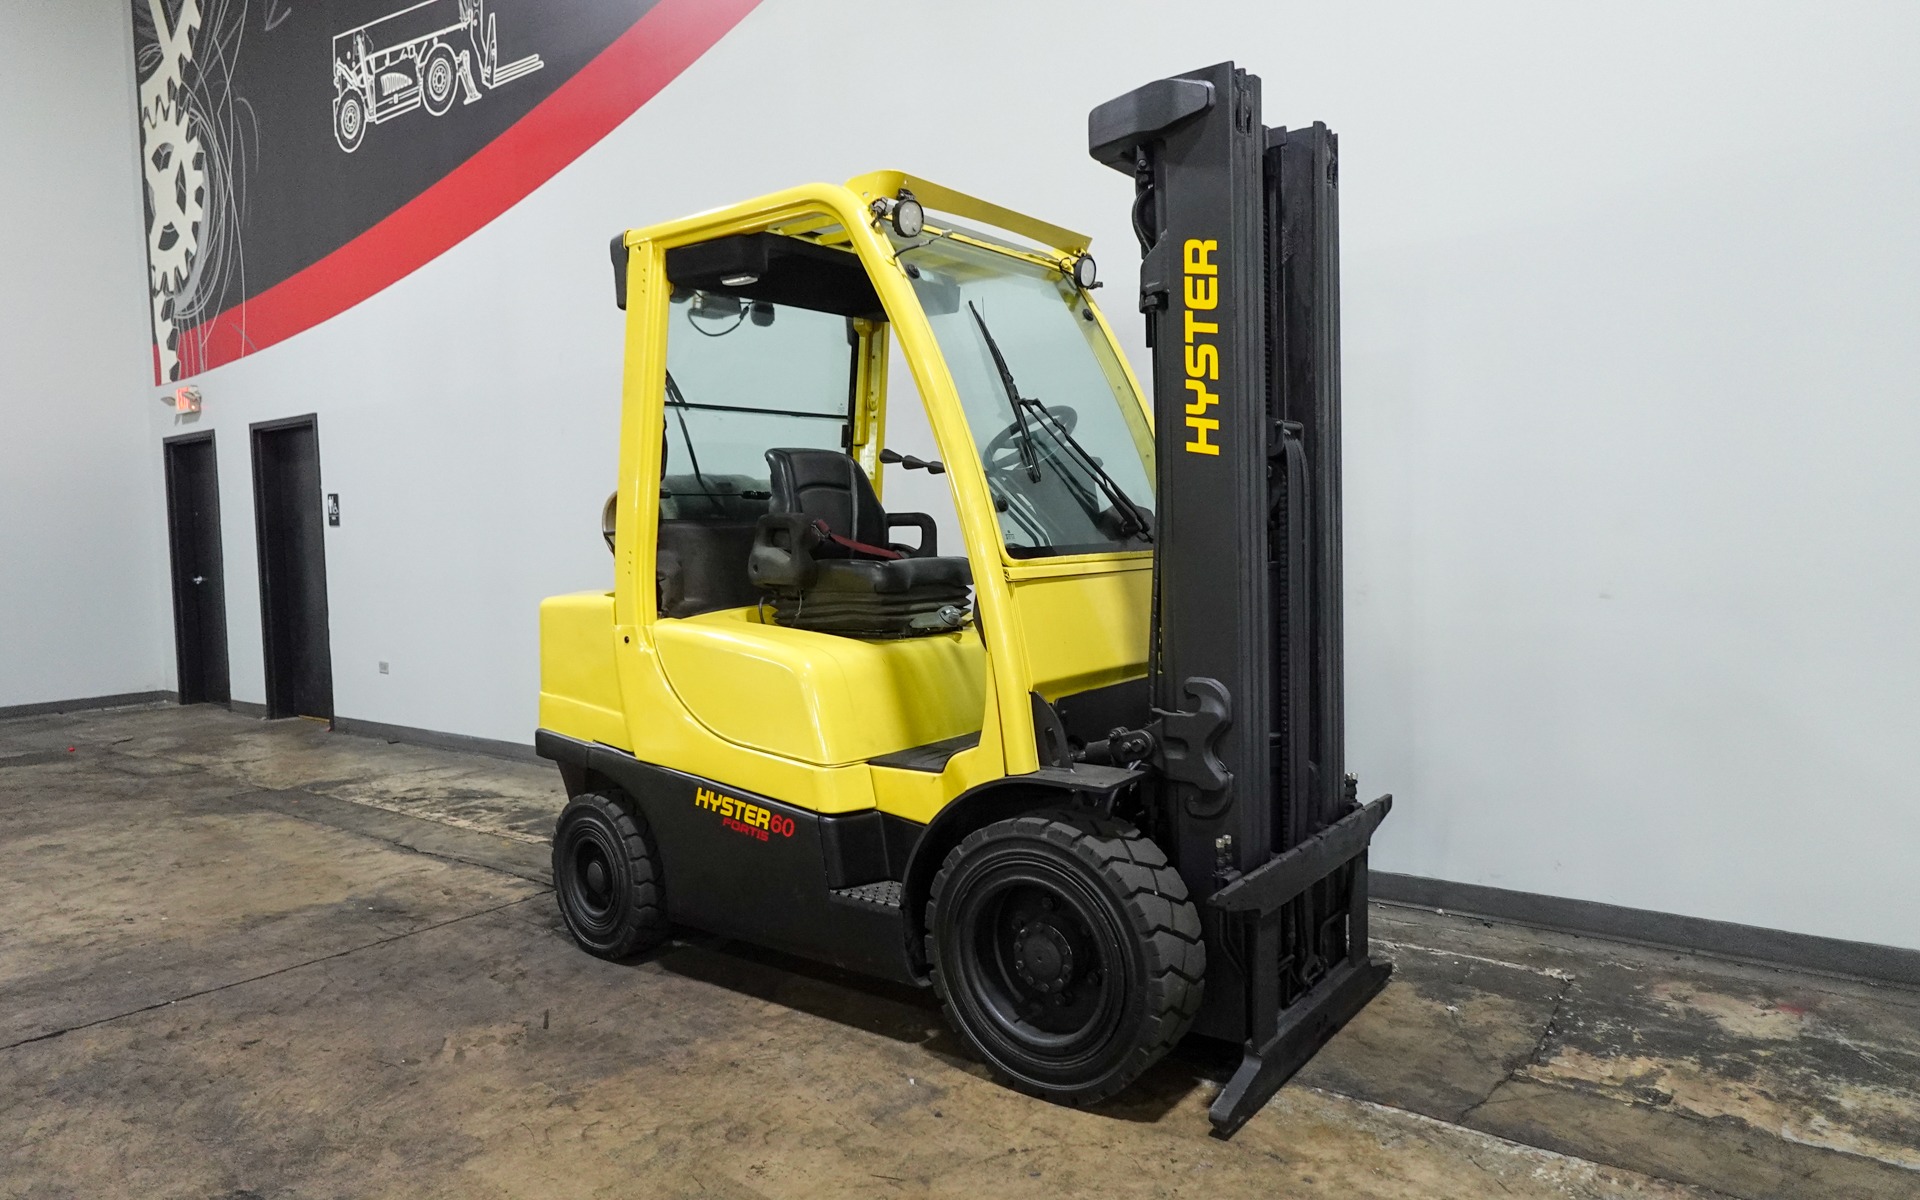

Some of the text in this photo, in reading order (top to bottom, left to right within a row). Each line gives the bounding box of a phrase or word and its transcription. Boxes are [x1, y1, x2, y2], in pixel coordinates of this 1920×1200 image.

[1183, 238, 1220, 456] HYSTER
[695, 787, 795, 837] HYSTER 60
[722, 817, 770, 842] FORTIS
